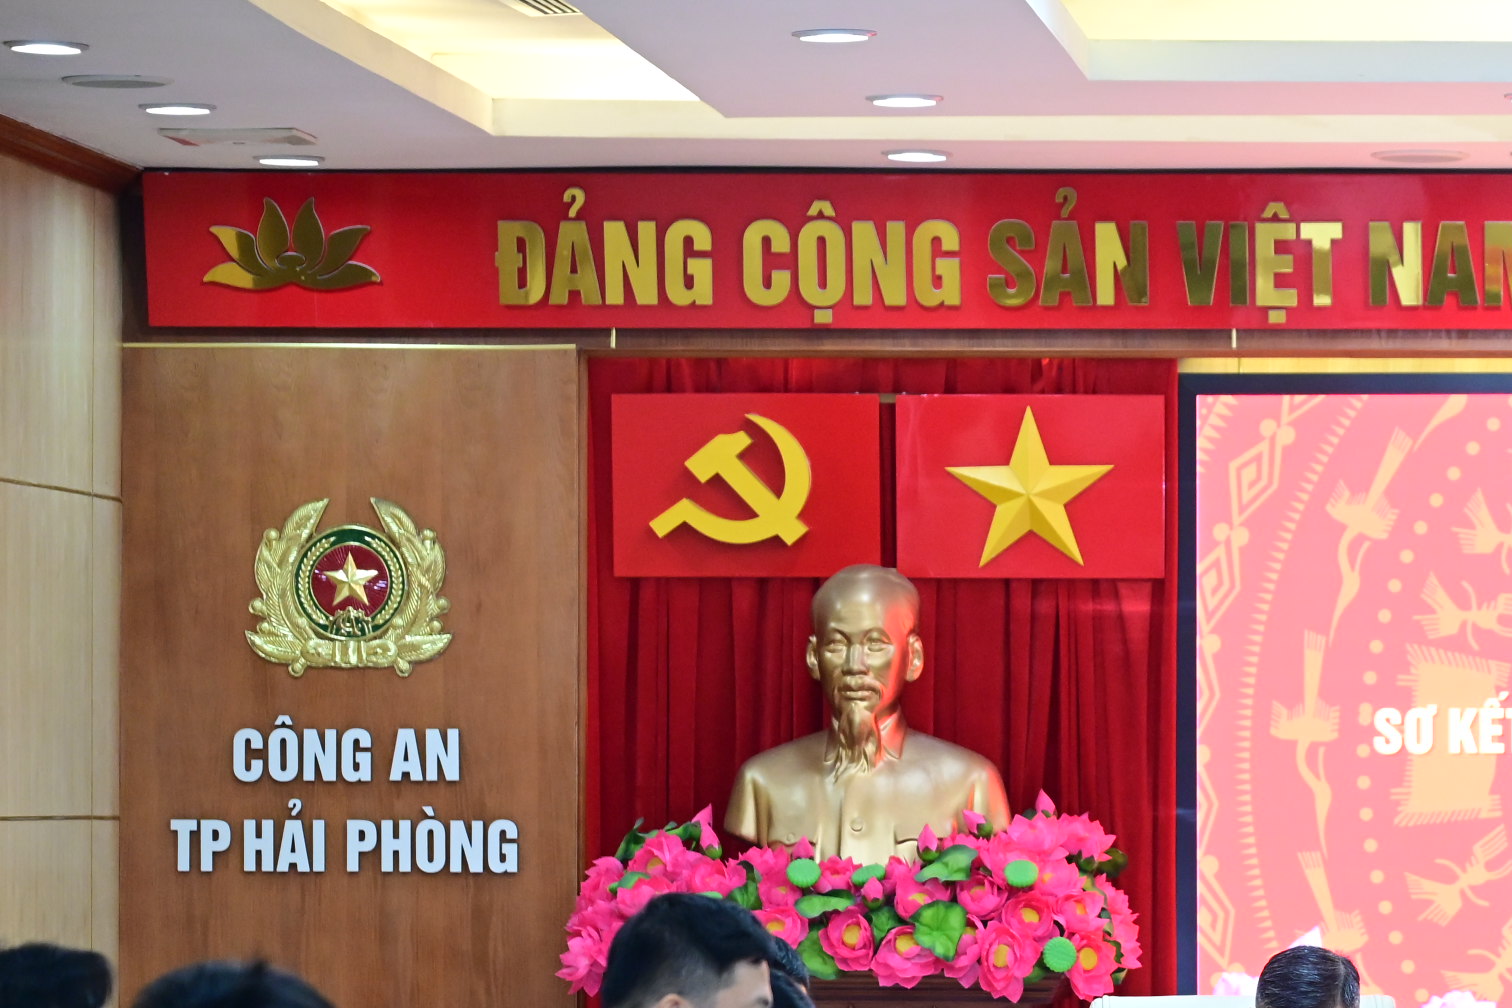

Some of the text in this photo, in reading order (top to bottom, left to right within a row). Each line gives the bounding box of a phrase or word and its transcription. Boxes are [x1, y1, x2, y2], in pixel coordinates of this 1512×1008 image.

[495, 187, 713, 305] ĐẢNG
[742, 199, 961, 323] CỘNG
[987, 187, 1149, 306] SẢN
[1176, 202, 1343, 323] VIỆT
[232, 715, 460, 783] CÔNG AN
[1373, 704, 1437, 755] SƠ
[170, 798, 519, 873] TP HẢI PHÒNG
